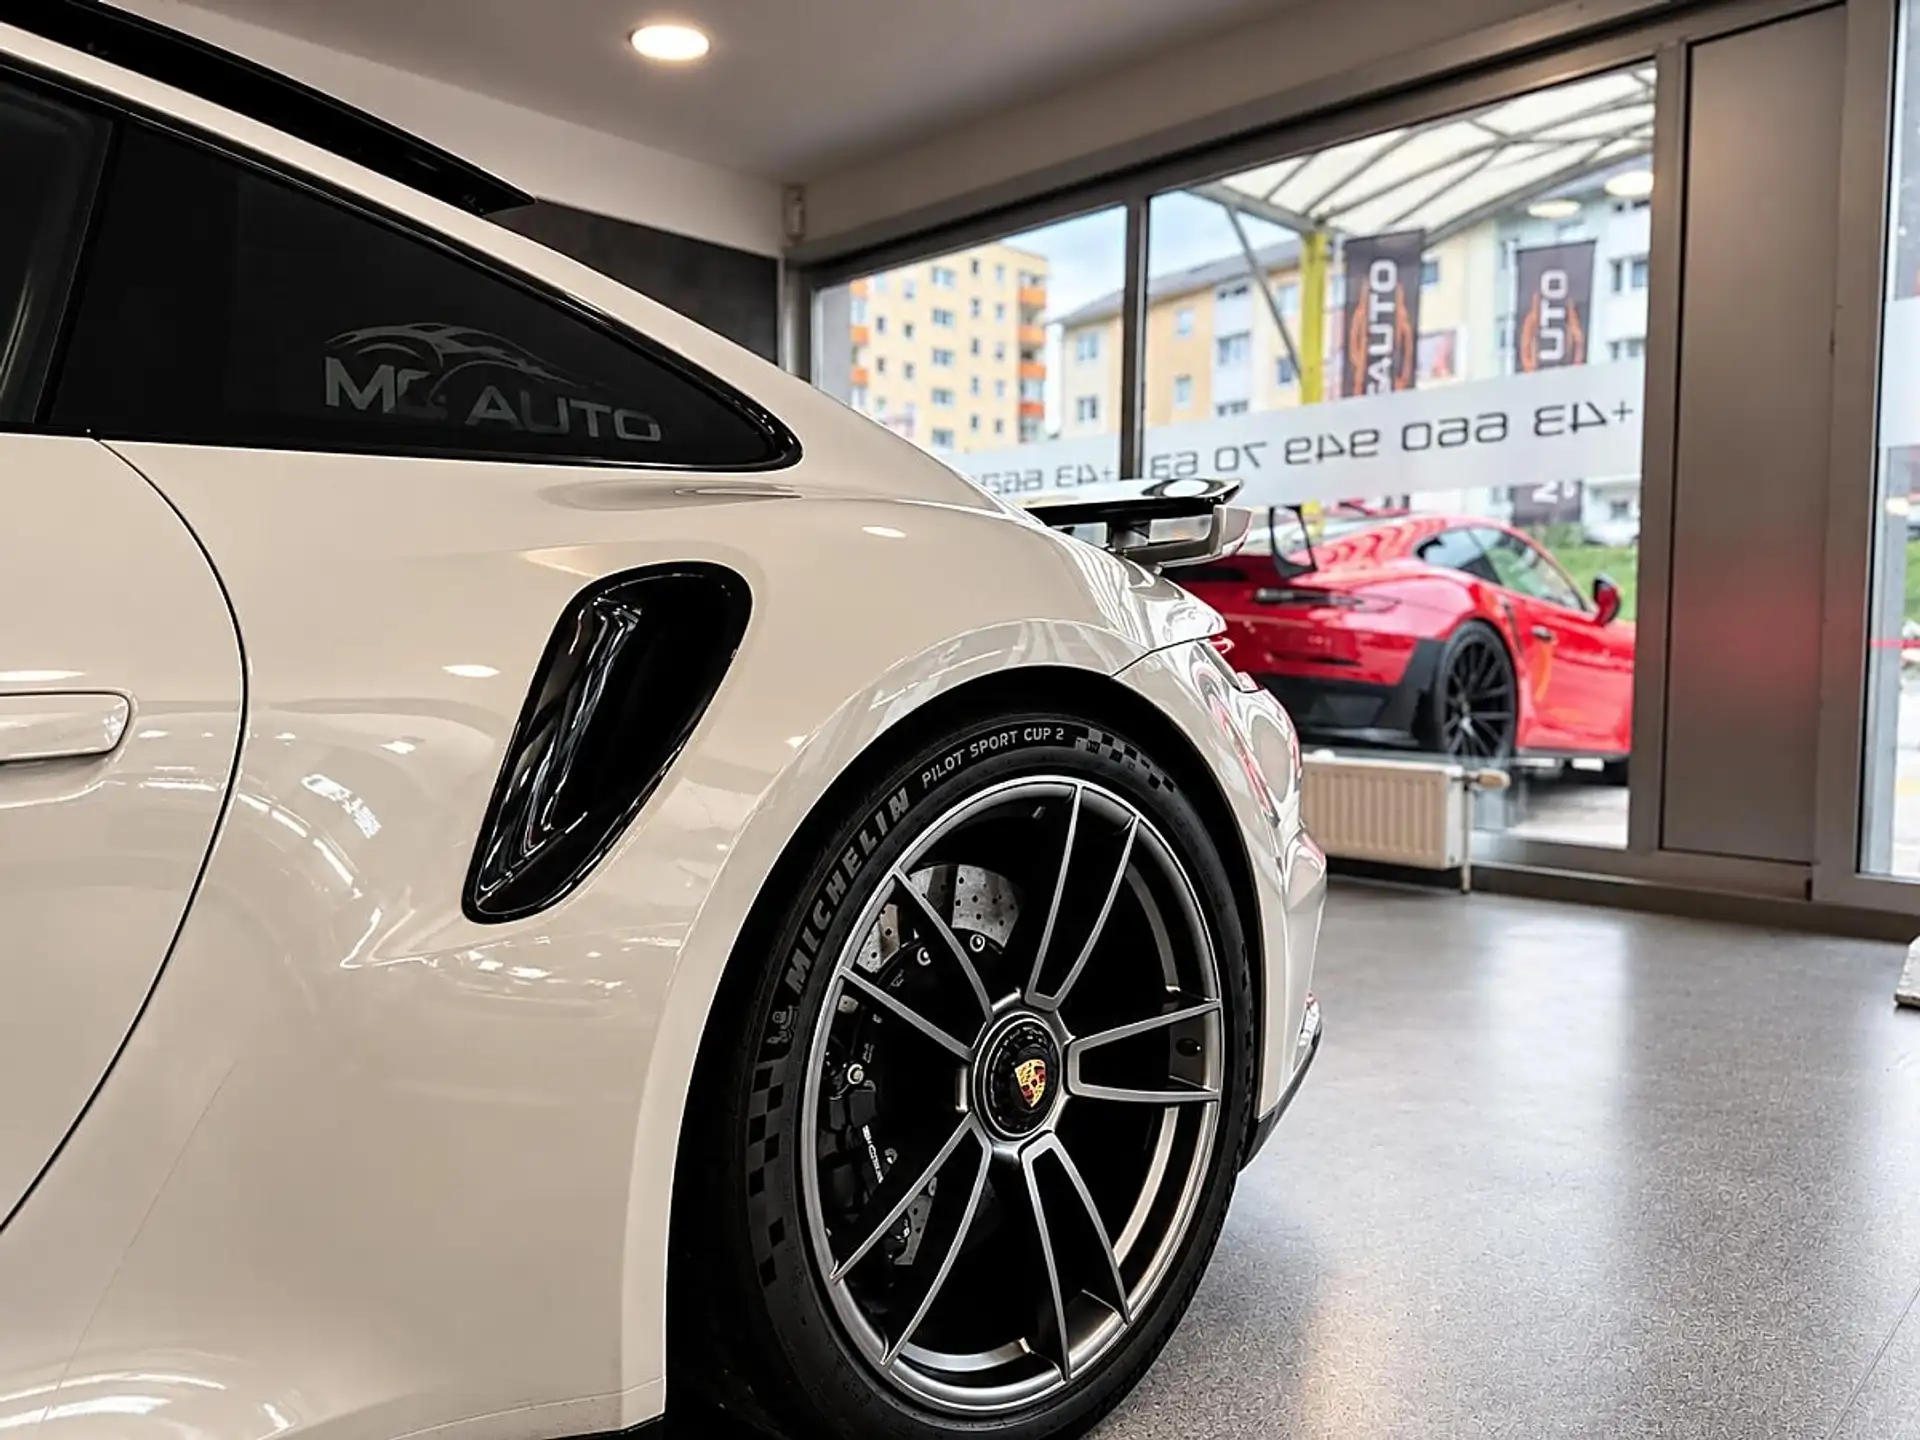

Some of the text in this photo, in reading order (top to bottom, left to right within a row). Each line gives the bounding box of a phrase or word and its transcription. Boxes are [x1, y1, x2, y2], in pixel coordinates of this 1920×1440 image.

[1540, 269, 1568, 361] UTO
[465, 385, 662, 442] AUTO
[785, 727, 1064, 995] MICHELIN PILOT SPORT CUP 2
